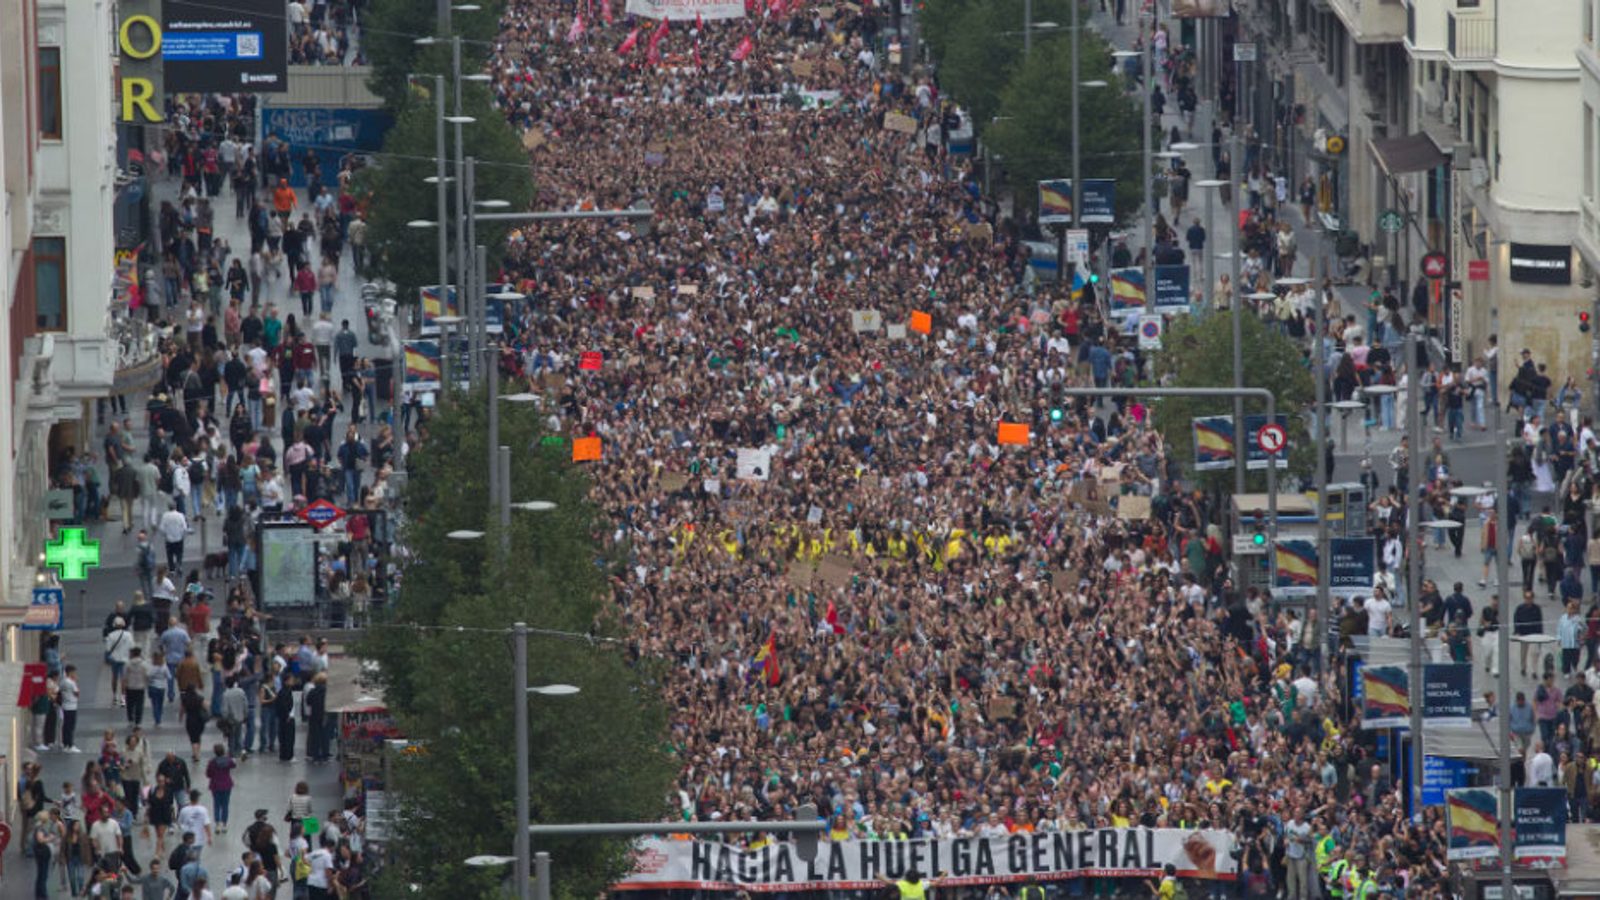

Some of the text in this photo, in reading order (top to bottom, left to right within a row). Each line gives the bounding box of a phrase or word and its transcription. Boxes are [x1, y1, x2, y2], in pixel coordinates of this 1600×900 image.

[691, 841, 795, 883] HACIA
[807, 840, 847, 881] LA
[860, 837, 996, 881] HUELGA
[1007, 829, 1162, 874] GENERAL
